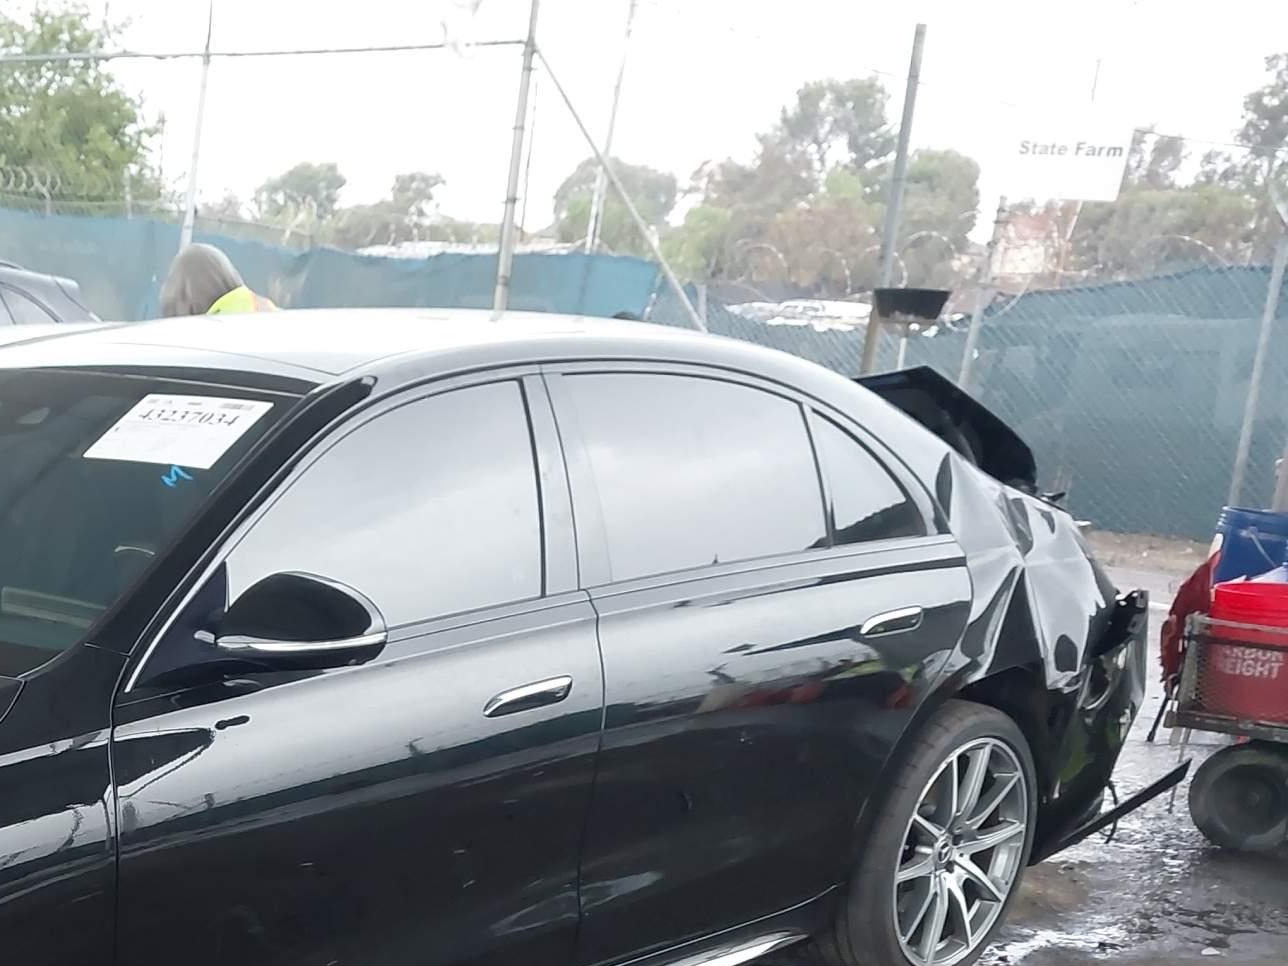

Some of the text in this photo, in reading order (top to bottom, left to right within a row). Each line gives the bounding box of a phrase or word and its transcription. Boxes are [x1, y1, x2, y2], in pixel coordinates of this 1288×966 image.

[1019, 140, 1124, 158] State Farm
[137, 408, 241, 427] 43237034
